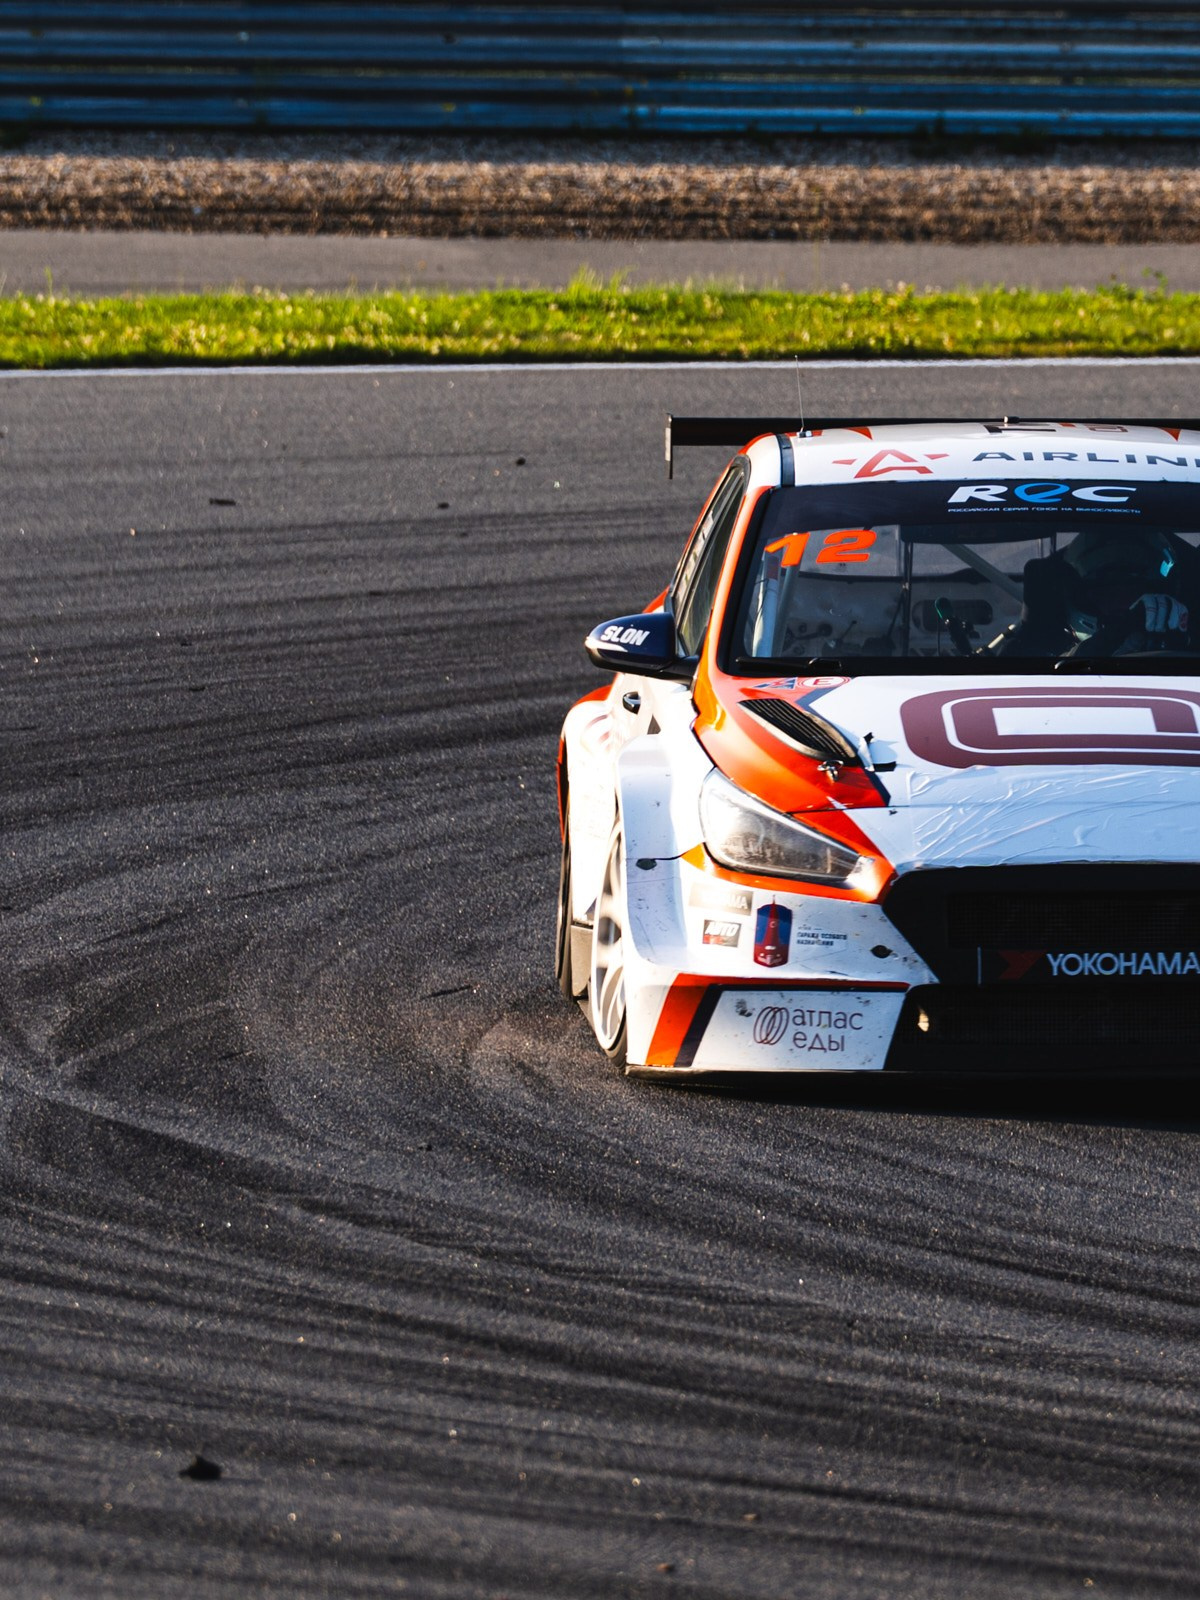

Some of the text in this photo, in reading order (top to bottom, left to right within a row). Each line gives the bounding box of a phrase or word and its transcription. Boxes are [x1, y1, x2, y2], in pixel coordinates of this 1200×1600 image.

[764, 529, 877, 568] 12
[600, 625, 651, 646] SLON
[792, 1008, 864, 1030] атлас
[792, 1031, 845, 1053] еды
